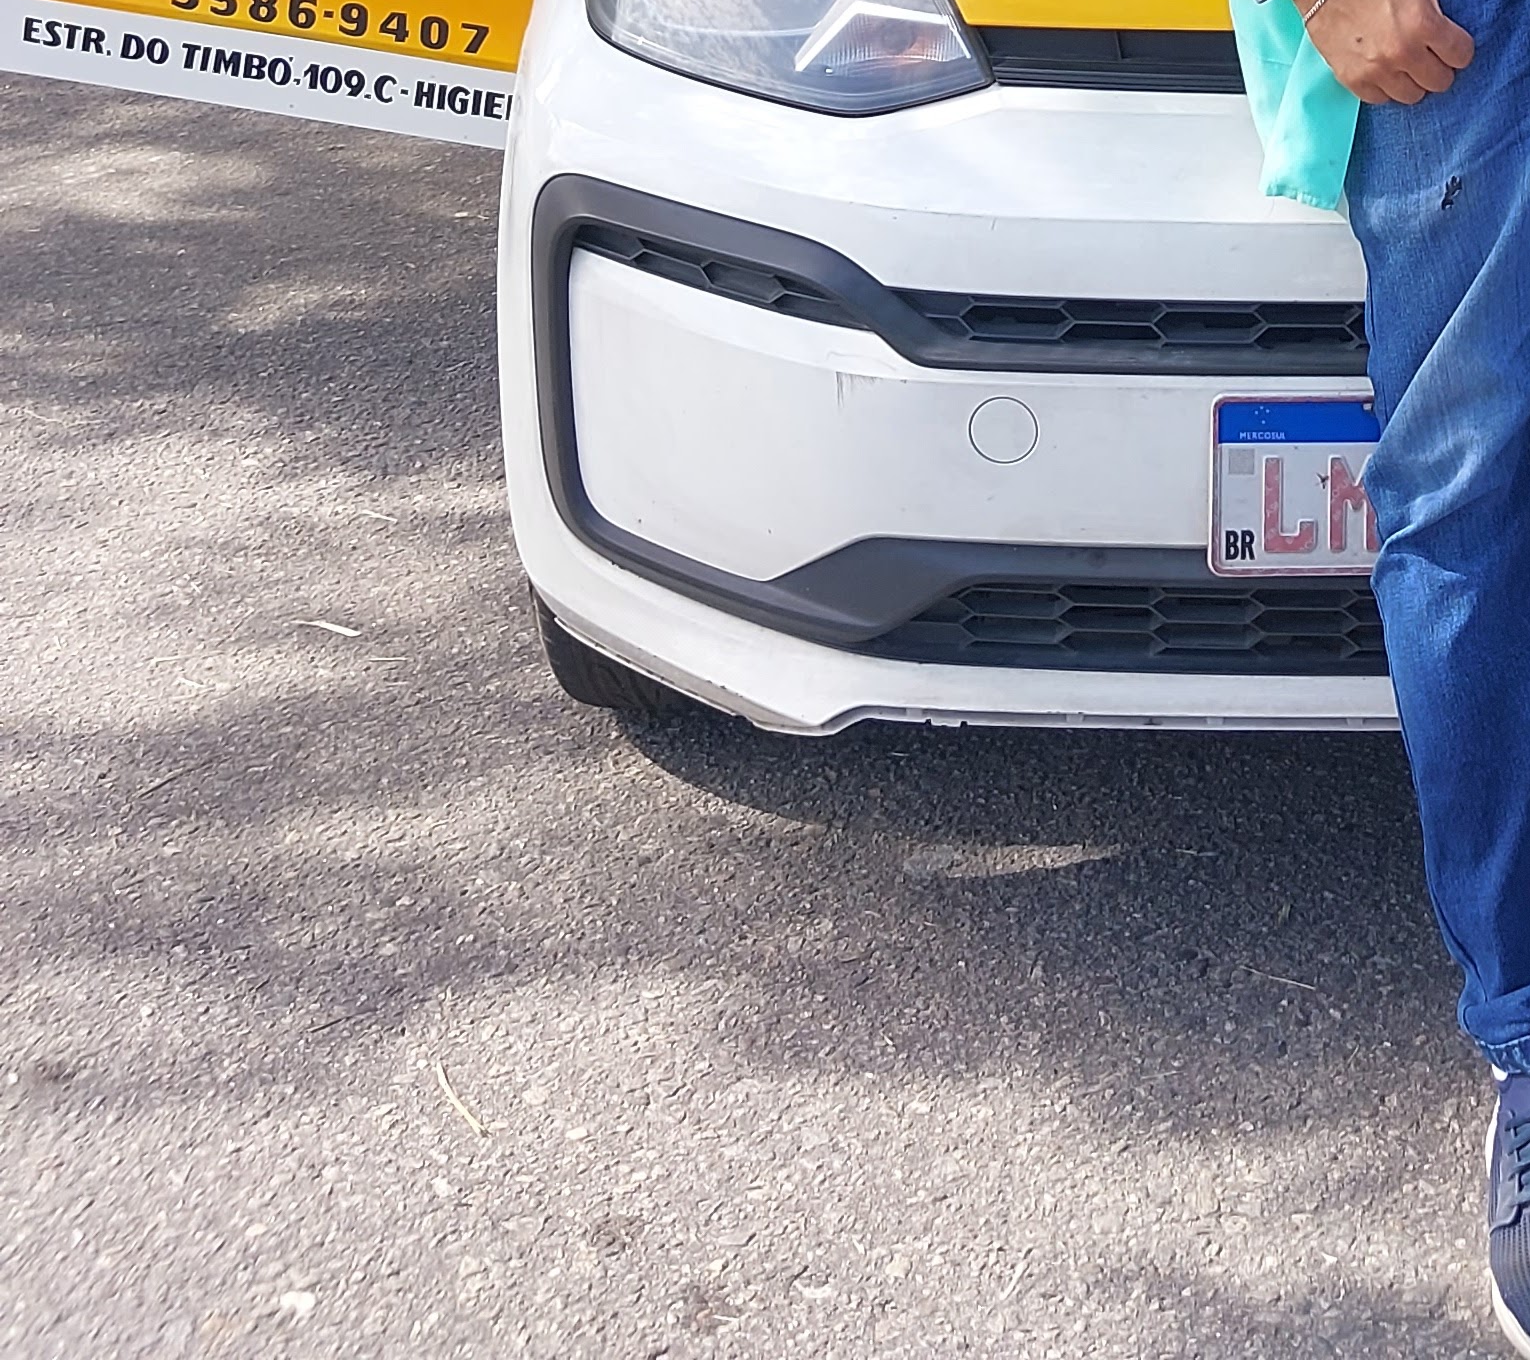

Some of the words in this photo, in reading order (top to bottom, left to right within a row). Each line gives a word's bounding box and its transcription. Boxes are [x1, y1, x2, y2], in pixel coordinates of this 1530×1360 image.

[22, 16, 112, 56] ESTR.
[120, 33, 170, 65] DO
[1239, 431, 1287, 441] MERCOSUL
[1225, 530, 1256, 561] BR
